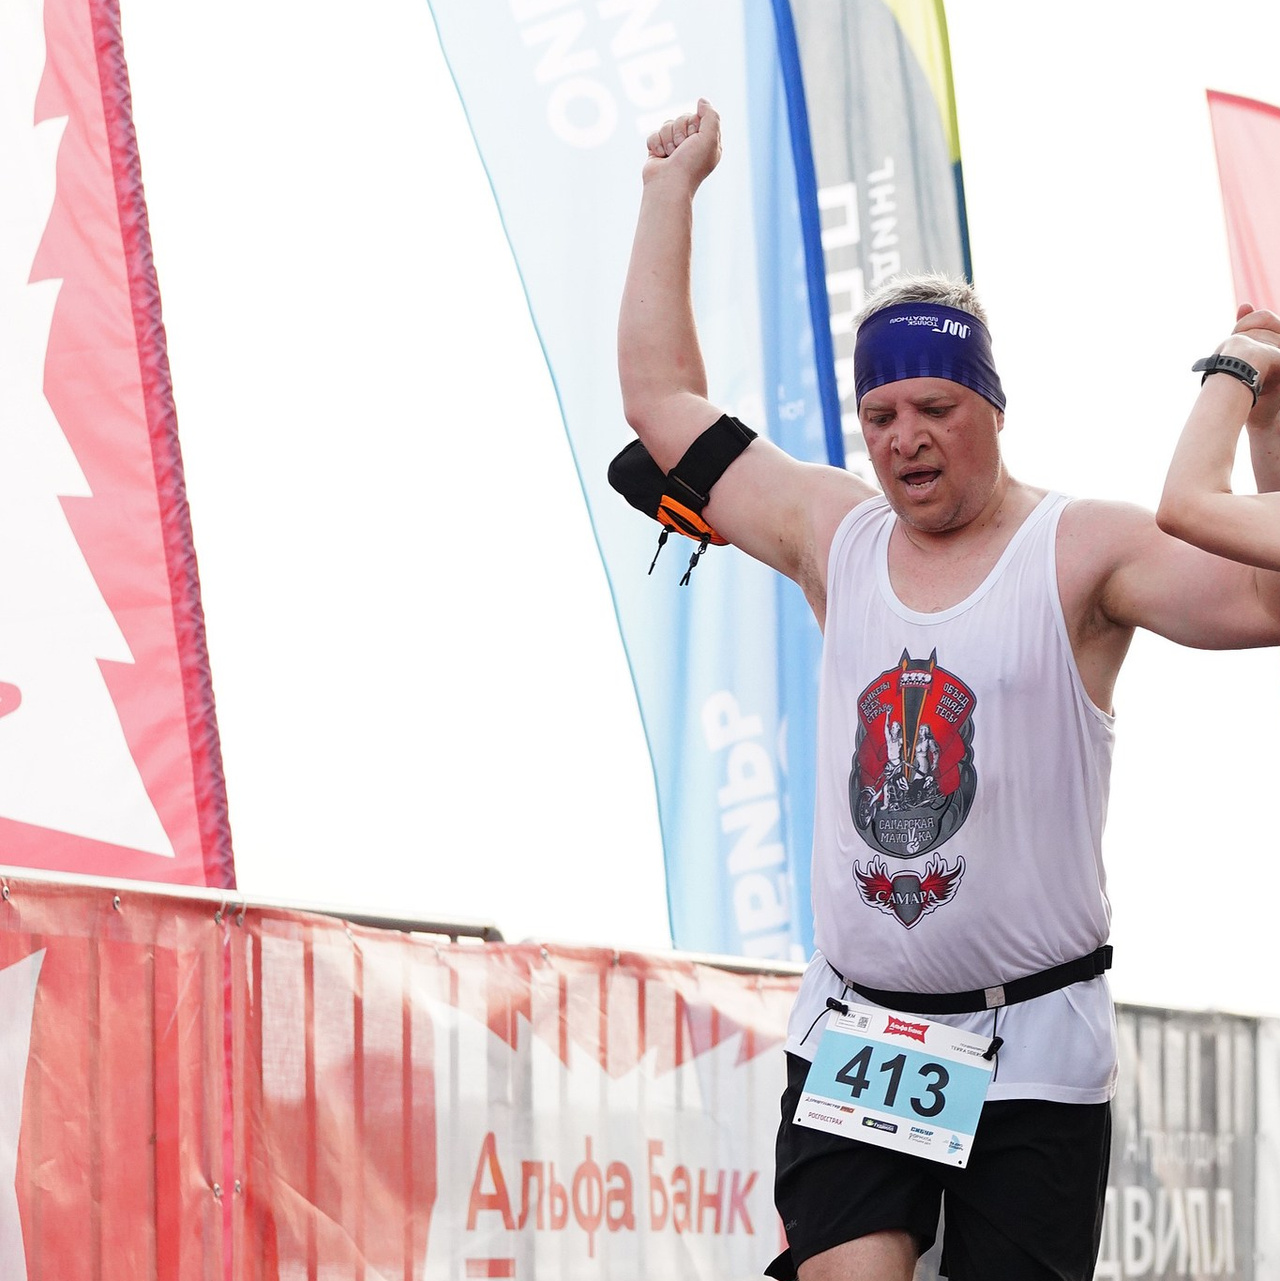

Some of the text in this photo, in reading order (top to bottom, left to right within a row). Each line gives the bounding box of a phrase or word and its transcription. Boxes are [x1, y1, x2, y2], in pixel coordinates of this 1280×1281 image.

[875, 889, 938, 905] САМАРА
[835, 1045, 950, 1118] 413
[466, 1131, 760, 1259] Альфа Банк
